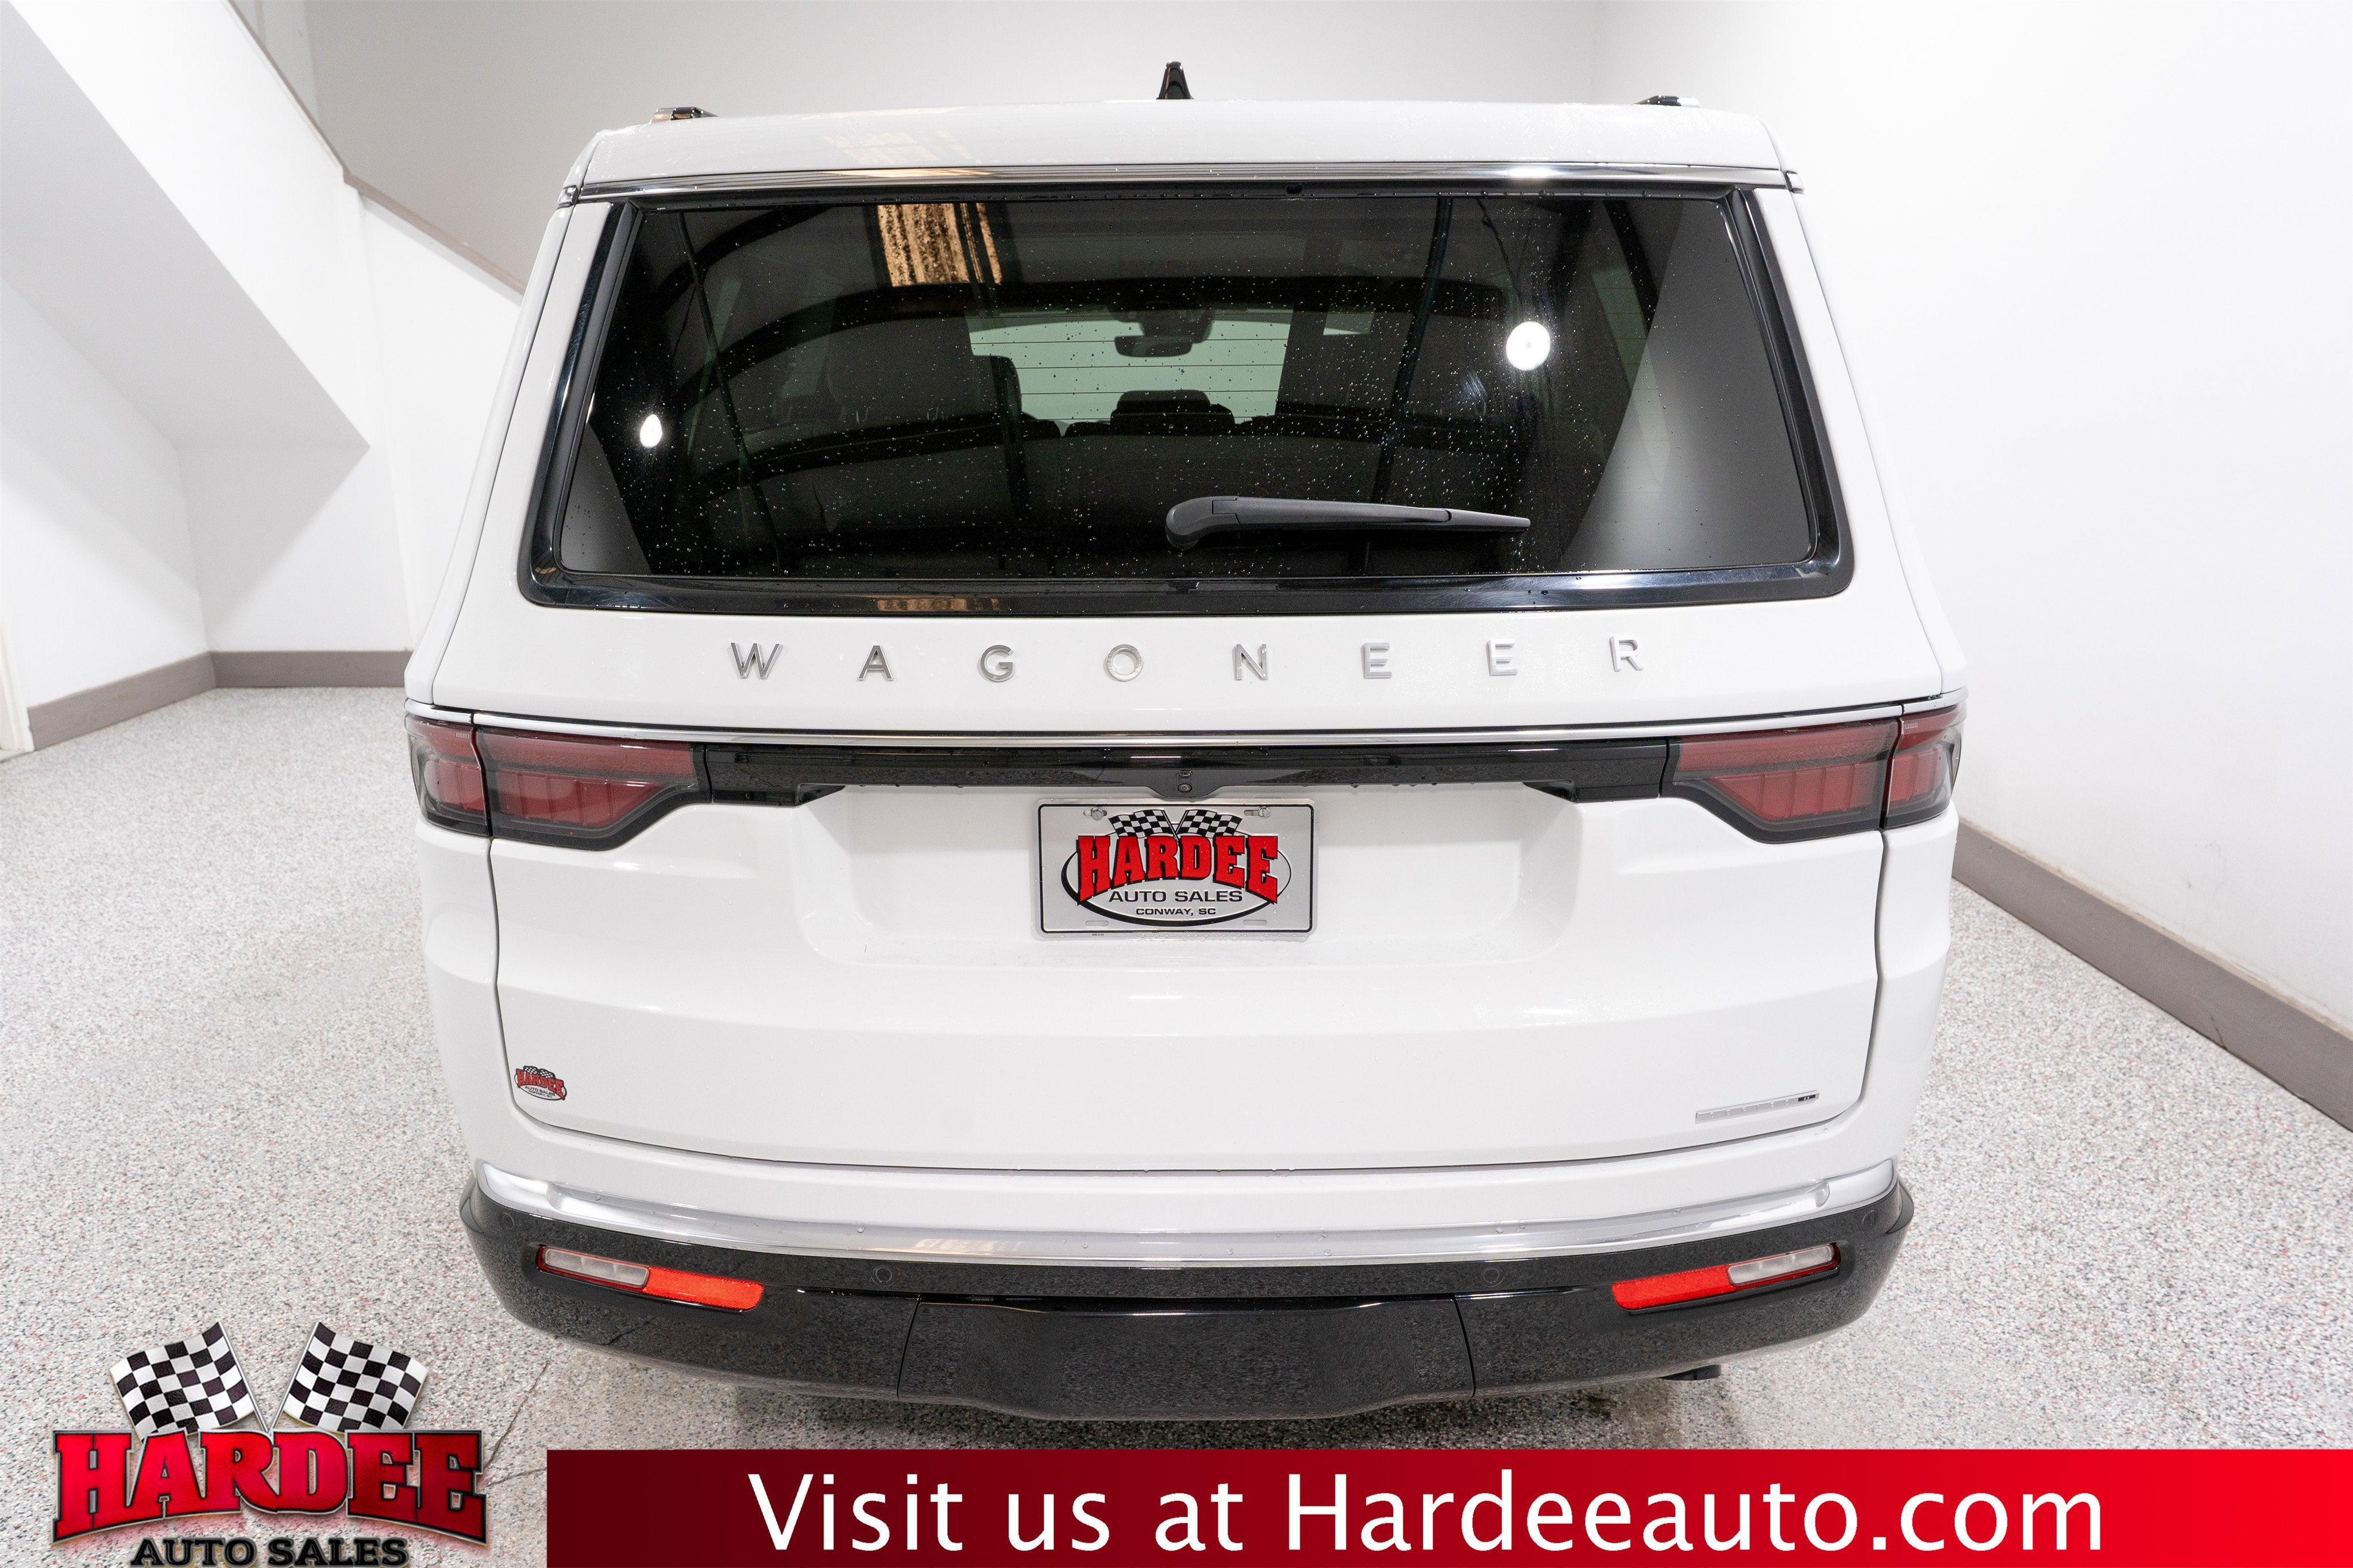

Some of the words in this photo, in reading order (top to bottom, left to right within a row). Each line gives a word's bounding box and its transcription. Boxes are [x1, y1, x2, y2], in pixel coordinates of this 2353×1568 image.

[730, 635, 1644, 683] WAGONEER
[1076, 835, 1279, 906] HARDEE
[1108, 890, 1172, 903] AUTO
[1174, 890, 1243, 903] SALES
[1136, 907, 1194, 916] CONWAY,
[516, 1069, 564, 1099] HARDEE
